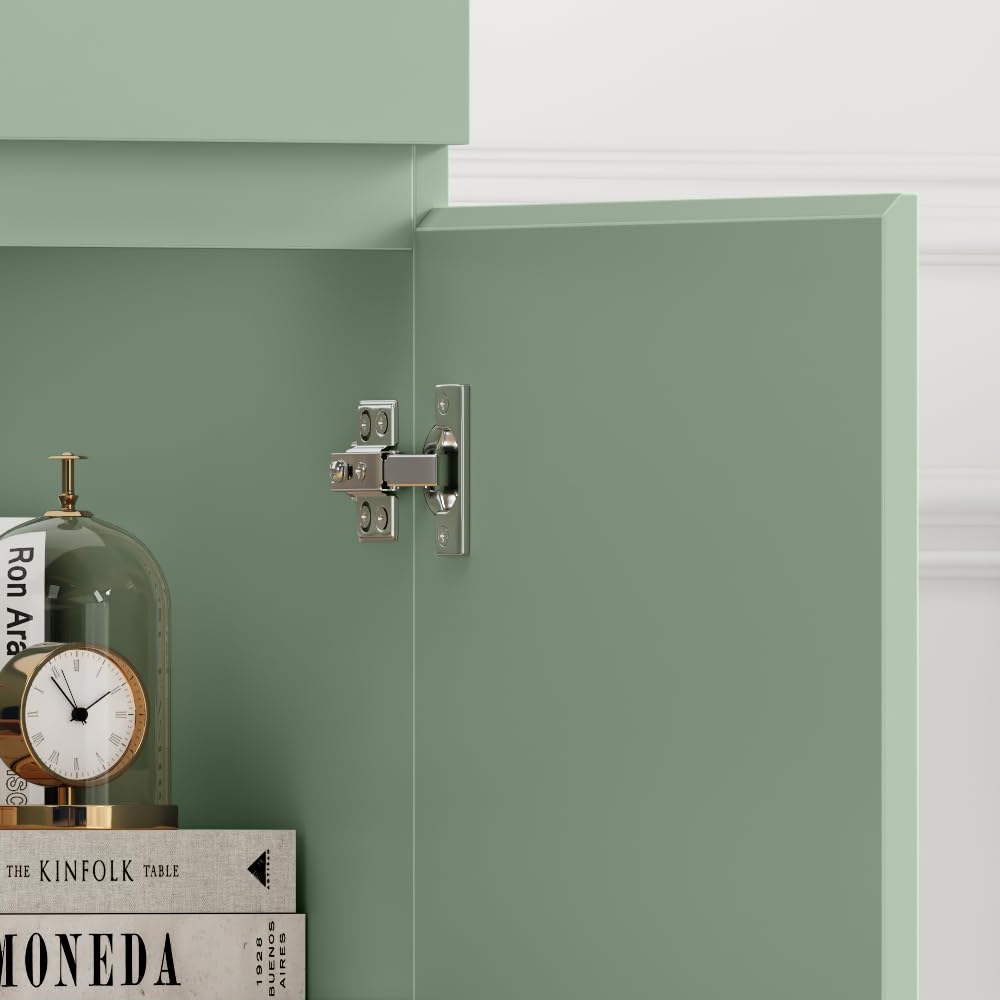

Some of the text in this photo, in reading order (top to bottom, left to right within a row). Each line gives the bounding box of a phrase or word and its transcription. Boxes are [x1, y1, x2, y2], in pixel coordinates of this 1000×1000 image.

[6, 547, 34, 656] Ron Ara
[6, 859, 180, 882] THE KINFOLK TABLE
[268, 920, 276, 997] BUENOS
